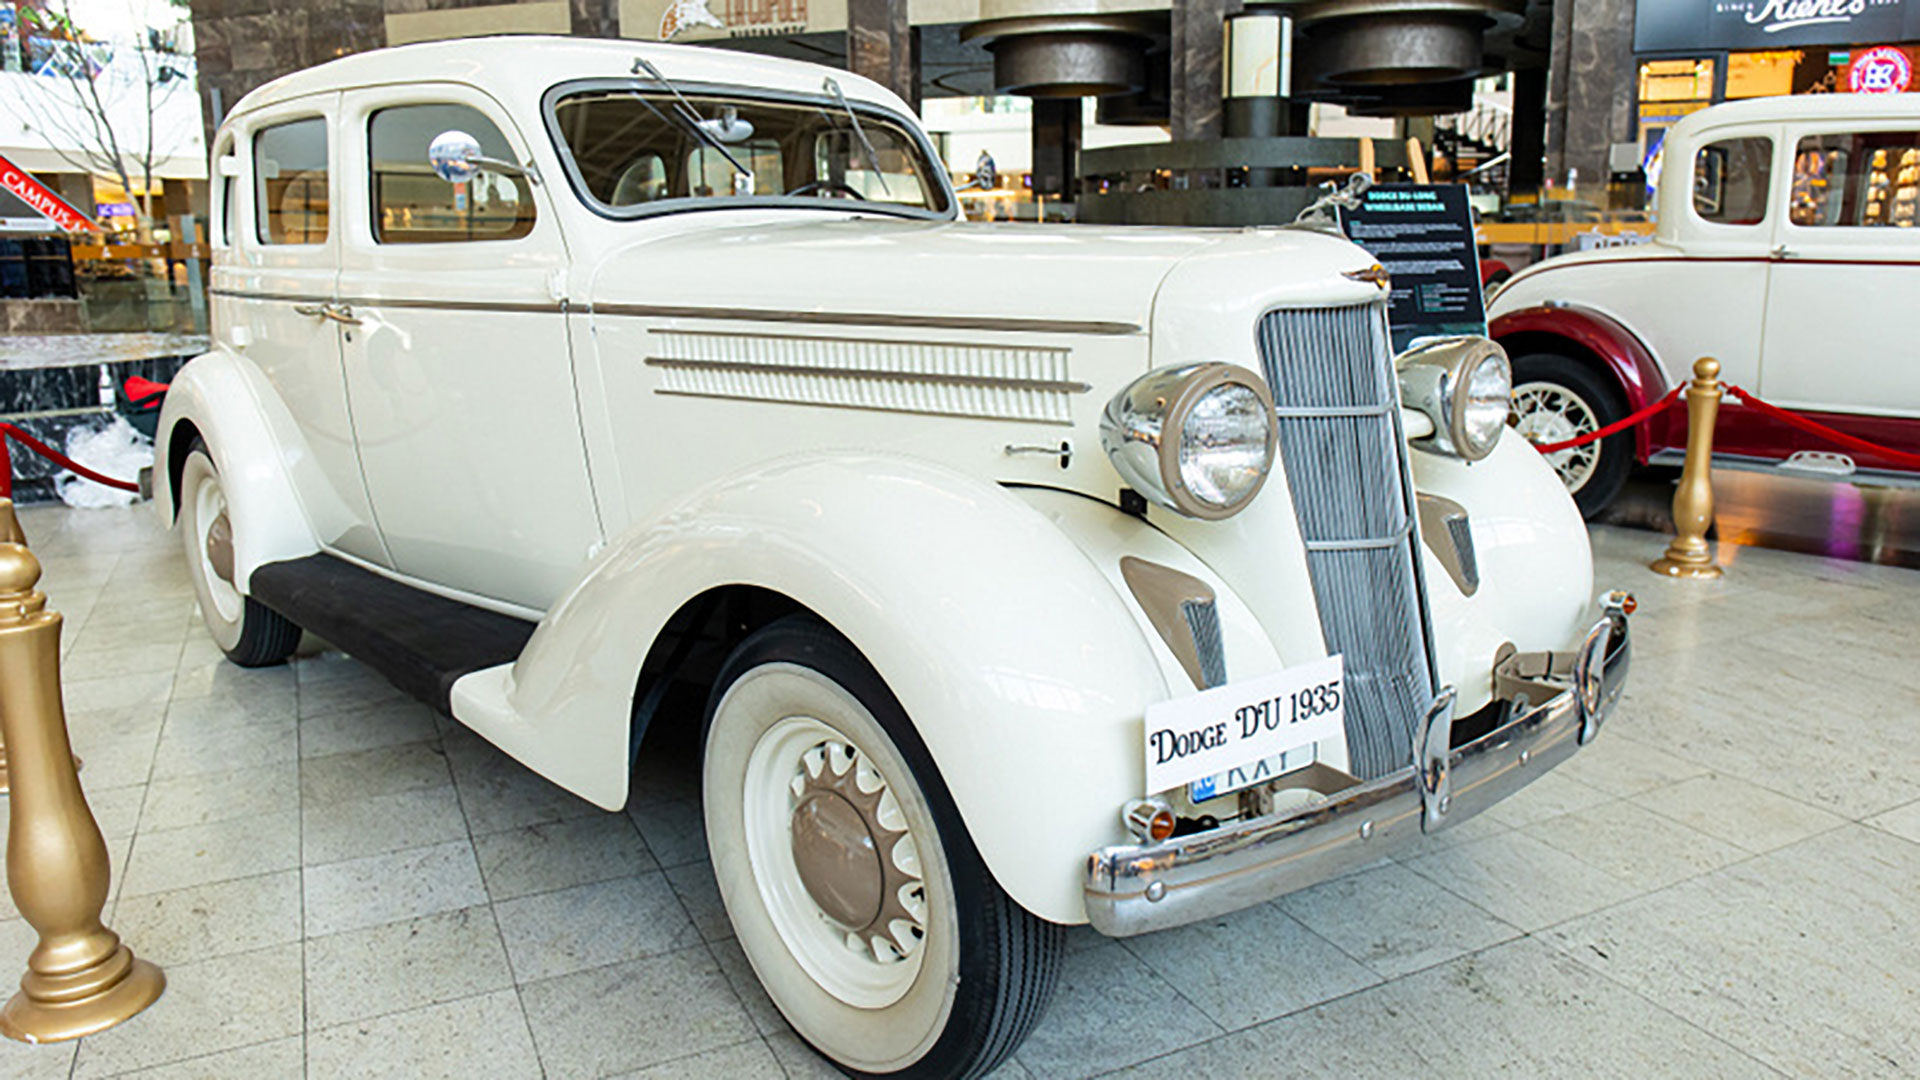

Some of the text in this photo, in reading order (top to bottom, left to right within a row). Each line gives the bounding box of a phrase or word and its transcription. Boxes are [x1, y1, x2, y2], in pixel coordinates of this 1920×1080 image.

[1744, 0, 1865, 24] Kiehls
[3, 171, 71, 225] CAMPUS
[1235, 697, 1282, 739] DU
[1290, 680, 1341, 724] 1935
